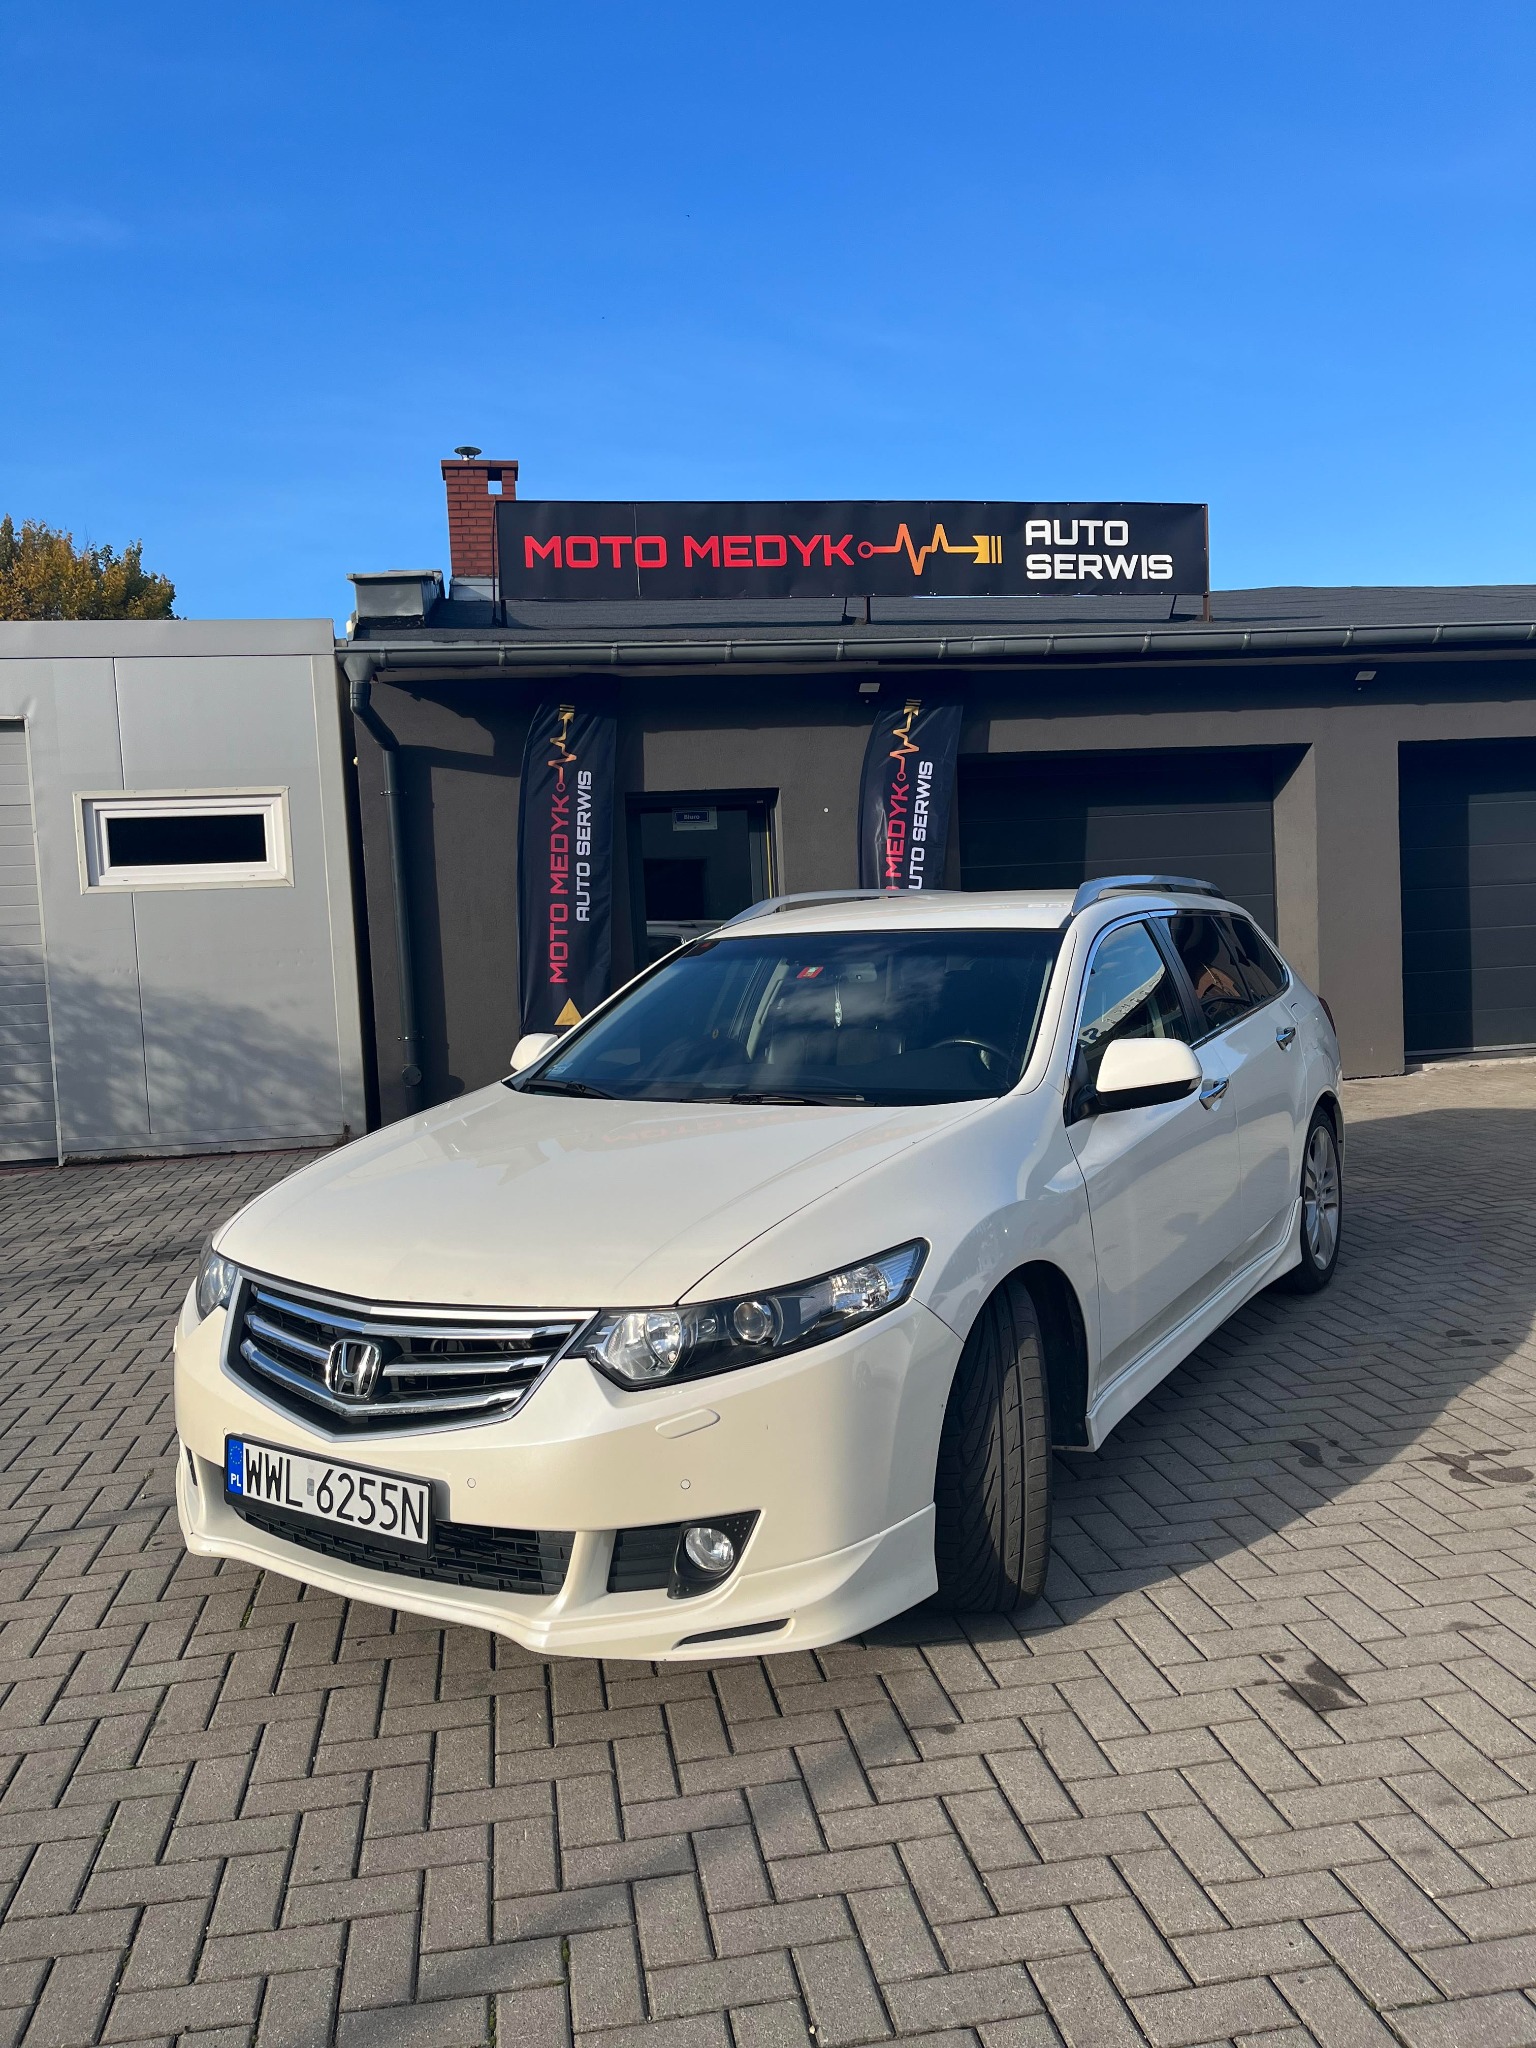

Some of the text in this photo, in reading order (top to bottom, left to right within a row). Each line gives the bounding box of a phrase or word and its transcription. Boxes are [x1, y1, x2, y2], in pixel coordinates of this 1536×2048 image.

[525, 533, 854, 569] MOTO MEDYK
[1025, 519, 1128, 546] AUTO
[1026, 552, 1173, 579] SERWIS
[576, 770, 592, 922] AUTO SERWIS
[886, 782, 910, 878] MEDYK
[908, 760, 934, 889] UTO SERWIS
[550, 793, 570, 983] MOTO MEDYK
[230, 1472, 242, 1488] PL
[246, 1448, 424, 1539] WWL 6255N
